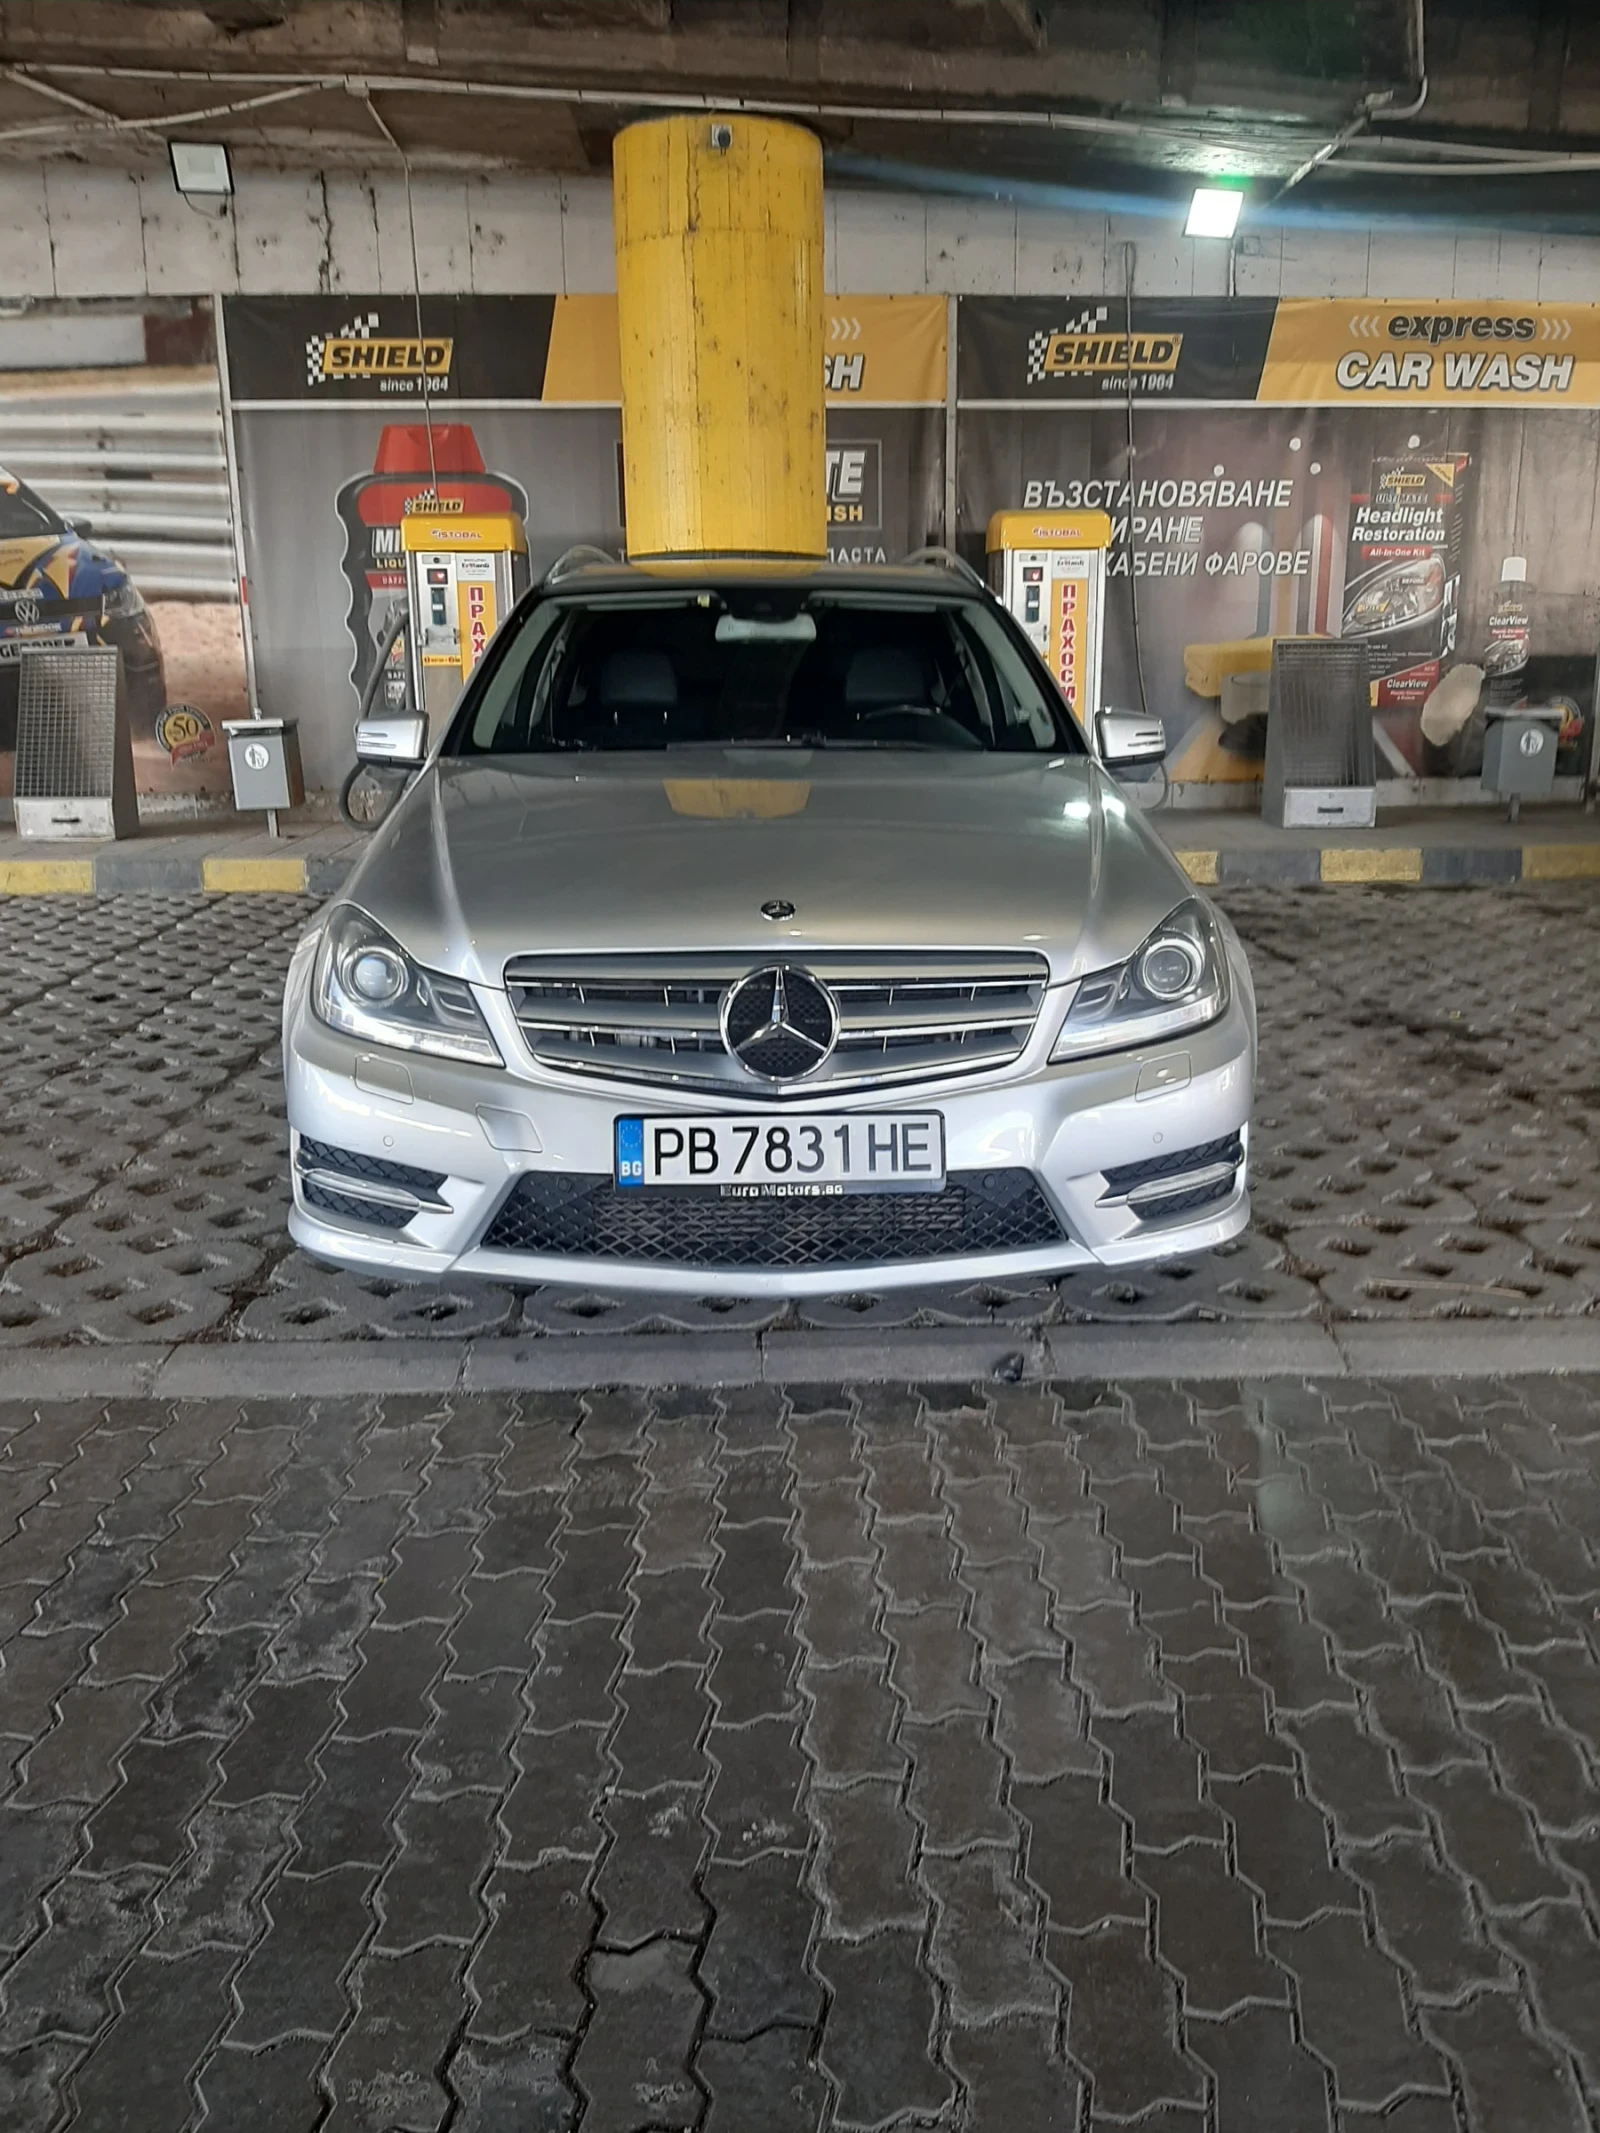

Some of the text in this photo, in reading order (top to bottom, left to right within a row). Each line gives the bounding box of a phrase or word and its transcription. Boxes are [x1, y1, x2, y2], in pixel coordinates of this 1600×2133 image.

[1387, 315, 1536, 345] express
[331, 345, 445, 369] SHIELD
[1053, 340, 1174, 365] SHIELD
[1336, 351, 1574, 390] CAR WASH
[379, 377, 414, 392] since
[1101, 375, 1137, 391] since
[1386, 475, 1424, 486] SHIELD
[1023, 479, 1294, 509] ВЪЗСТАНОВЯВАНЕ
[1356, 506, 1443, 527] Headlight
[438, 530, 482, 540] ISTOBAL
[1351, 526, 1446, 542] Restoration
[1370, 548, 1426, 557] All-In-One Kit
[1204, 550, 1312, 577] ФАРОВЕ
[1489, 616, 1529, 625] ClearView
[1060, 584, 1077, 707] ПРАХОСМ
[1387, 679, 1429, 689] ClearView
[173, 717, 199, 742] 50
[654, 1123, 932, 1176] PB 7831 HE
[621, 1161, 643, 1177] BG
[720, 1184, 759, 1197] Euro
